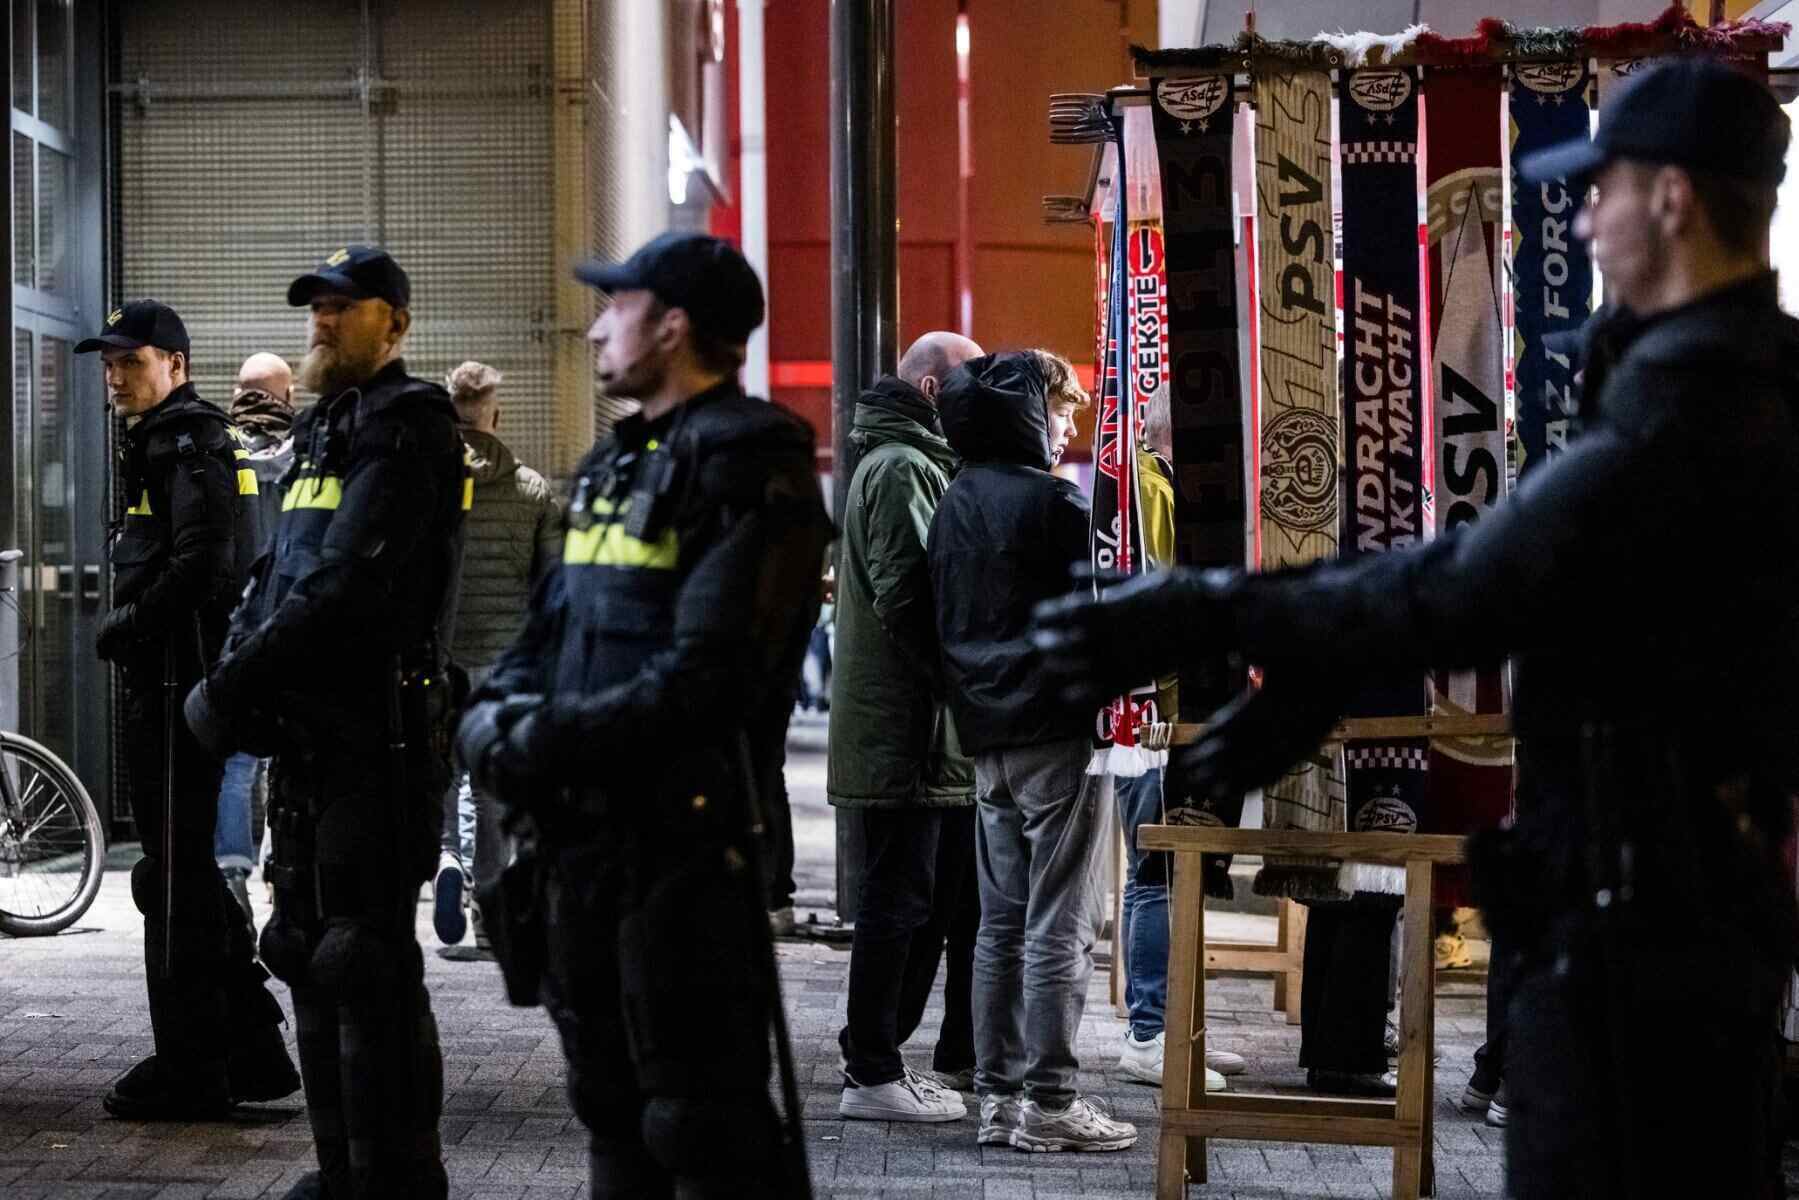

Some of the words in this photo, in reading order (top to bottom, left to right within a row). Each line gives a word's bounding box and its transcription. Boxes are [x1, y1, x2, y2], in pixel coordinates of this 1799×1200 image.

[1180, 88, 1205, 102] PSV
[1366, 84, 1389, 95] PSV
[1277, 153, 1325, 316] PSV
[1541, 175, 1573, 320] FORÇ
[1136, 274, 1161, 396] GEKSTE
[1387, 294, 1413, 457] MACHT
[1545, 380, 1571, 465] AZ
[1376, 813, 1400, 824] PSV
